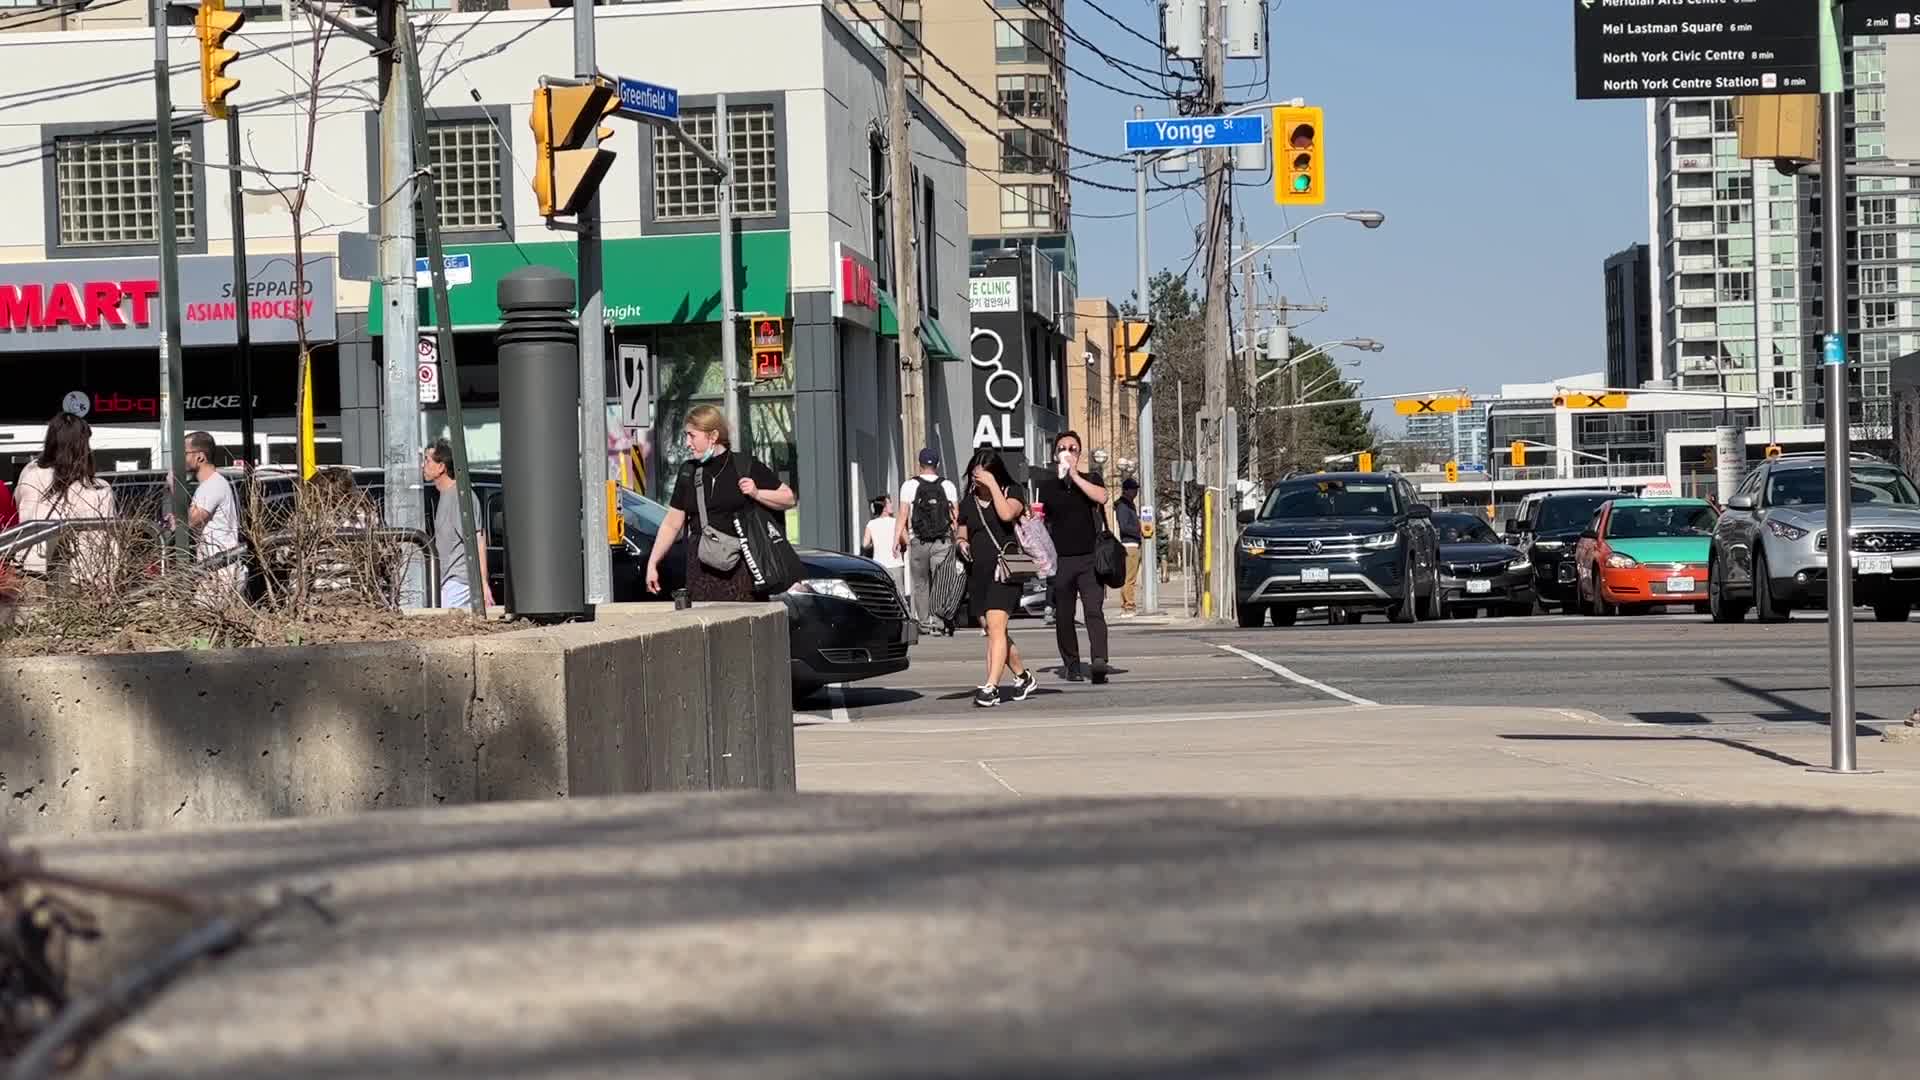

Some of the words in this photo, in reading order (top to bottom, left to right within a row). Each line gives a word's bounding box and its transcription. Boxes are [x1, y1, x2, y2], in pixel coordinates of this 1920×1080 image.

[1602, 23, 1623, 35] Mel
[1627, 23, 1678, 35] Lastman
[1681, 21, 1723, 35] Square
[1730, 23, 1736, 32] 6
[1737, 23, 1753, 32] min
[1865, 18, 1872, 27] 2
[1873, 17, 1889, 27] min
[1603, 51, 1638, 64] North
[1641, 50, 1669, 63] York
[1671, 50, 1702, 62] Civic
[1705, 49, 1745, 61] Centre
[1751, 51, 1758, 60] 8
[1758, 50, 1775, 60] min
[1603, 79, 1638, 91] North
[1641, 78, 1669, 90] York
[1672, 77, 1712, 89] Centre
[1715, 76, 1759, 88] Station
[1783, 77, 1790, 87] 8
[1790, 77, 1807, 86] min
[620, 82, 666, 111] Greenfield
[1155, 121, 1217, 145] Yonge
[1223, 119, 1234, 130] St
[423, 257, 459, 271] YGE
[221, 280, 313, 298] SEPPARD
[980, 281, 1011, 295] CLINIC
[0, 280, 159, 331] MART
[186, 302, 236, 321] ASIAN
[248, 300, 314, 321] ROCEY
[759, 354, 778, 375] 21
[183, 395, 259, 410] HICKE
